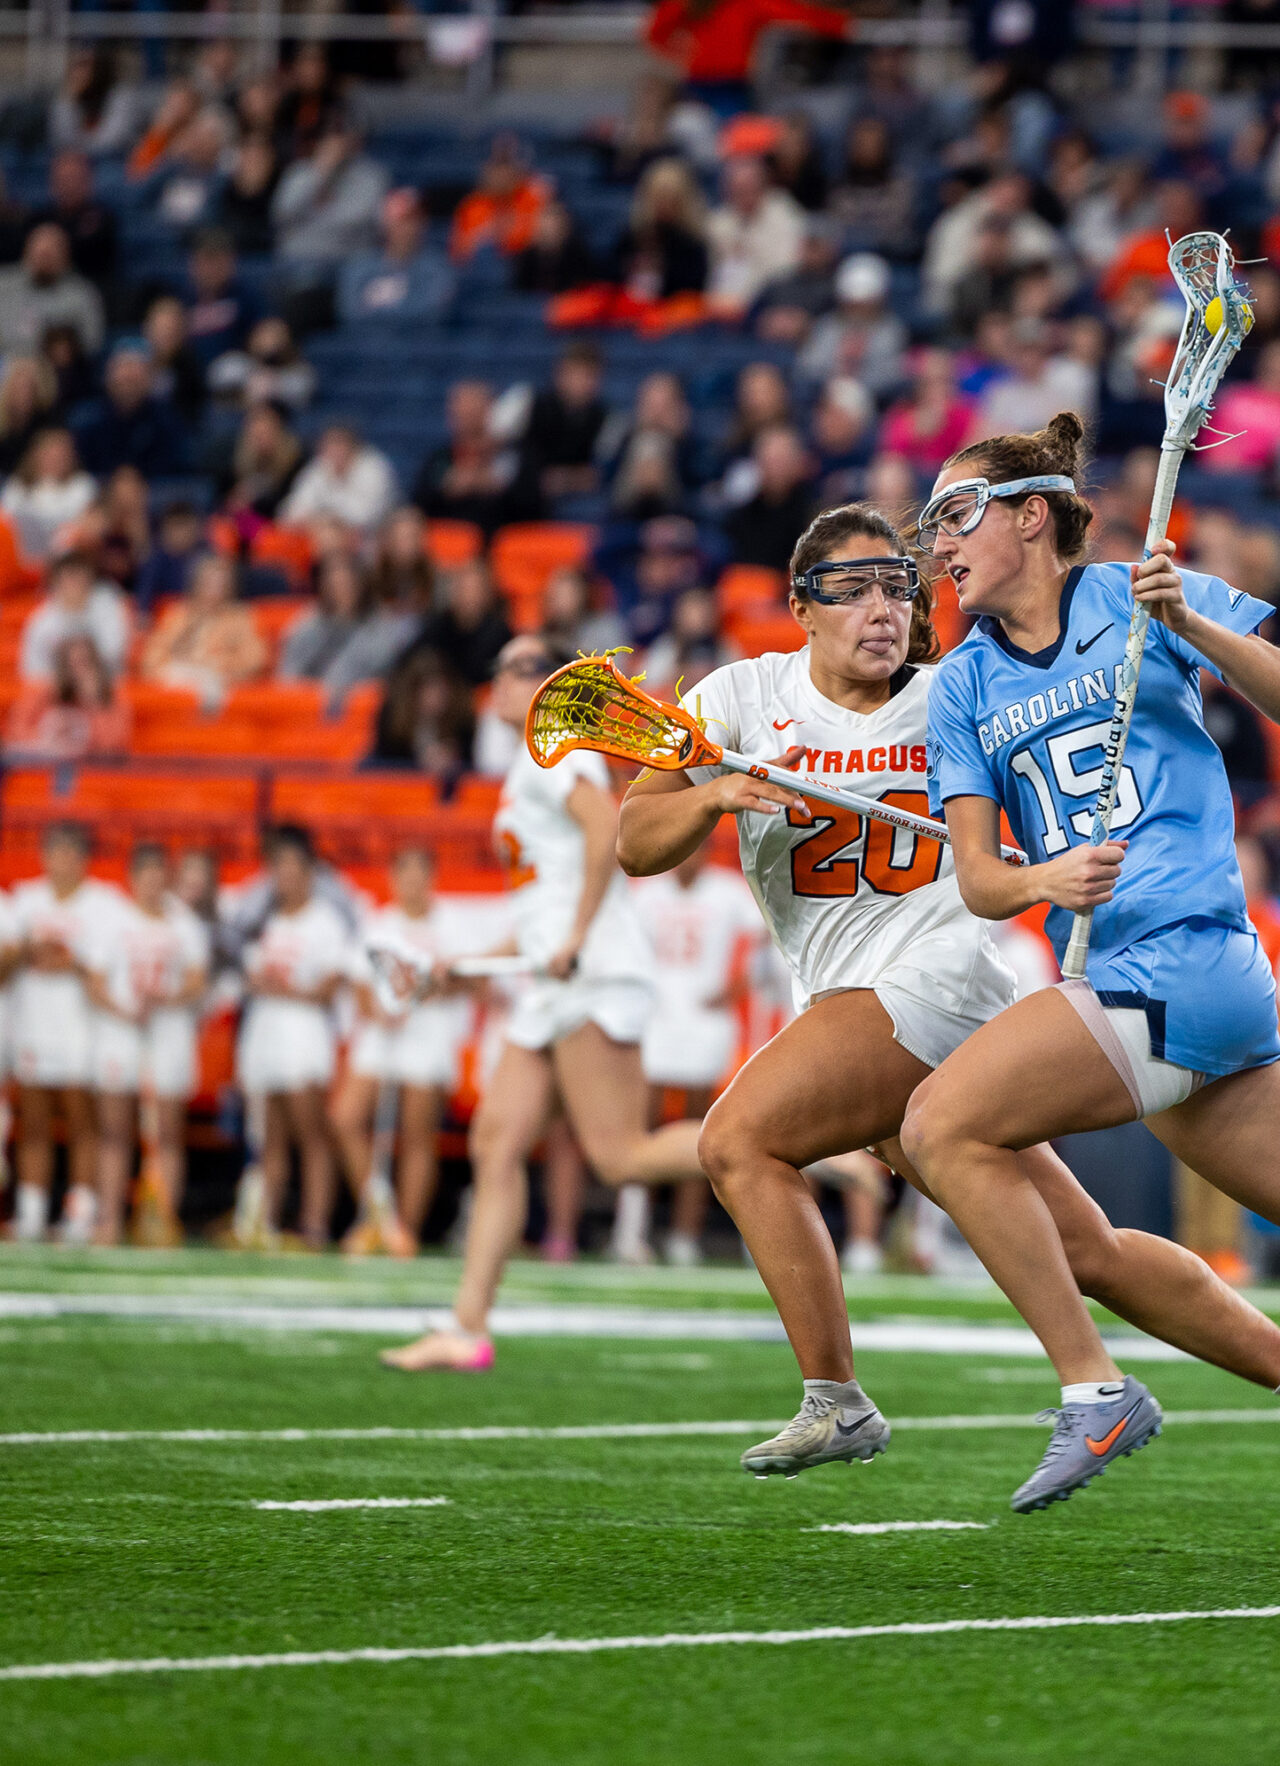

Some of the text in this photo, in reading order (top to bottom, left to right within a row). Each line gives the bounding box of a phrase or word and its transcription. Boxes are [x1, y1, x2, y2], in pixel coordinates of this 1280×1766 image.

[785, 788, 945, 899] 20
[867, 807, 949, 841] HEART HUSTLE
[1010, 718, 1145, 858] 15
